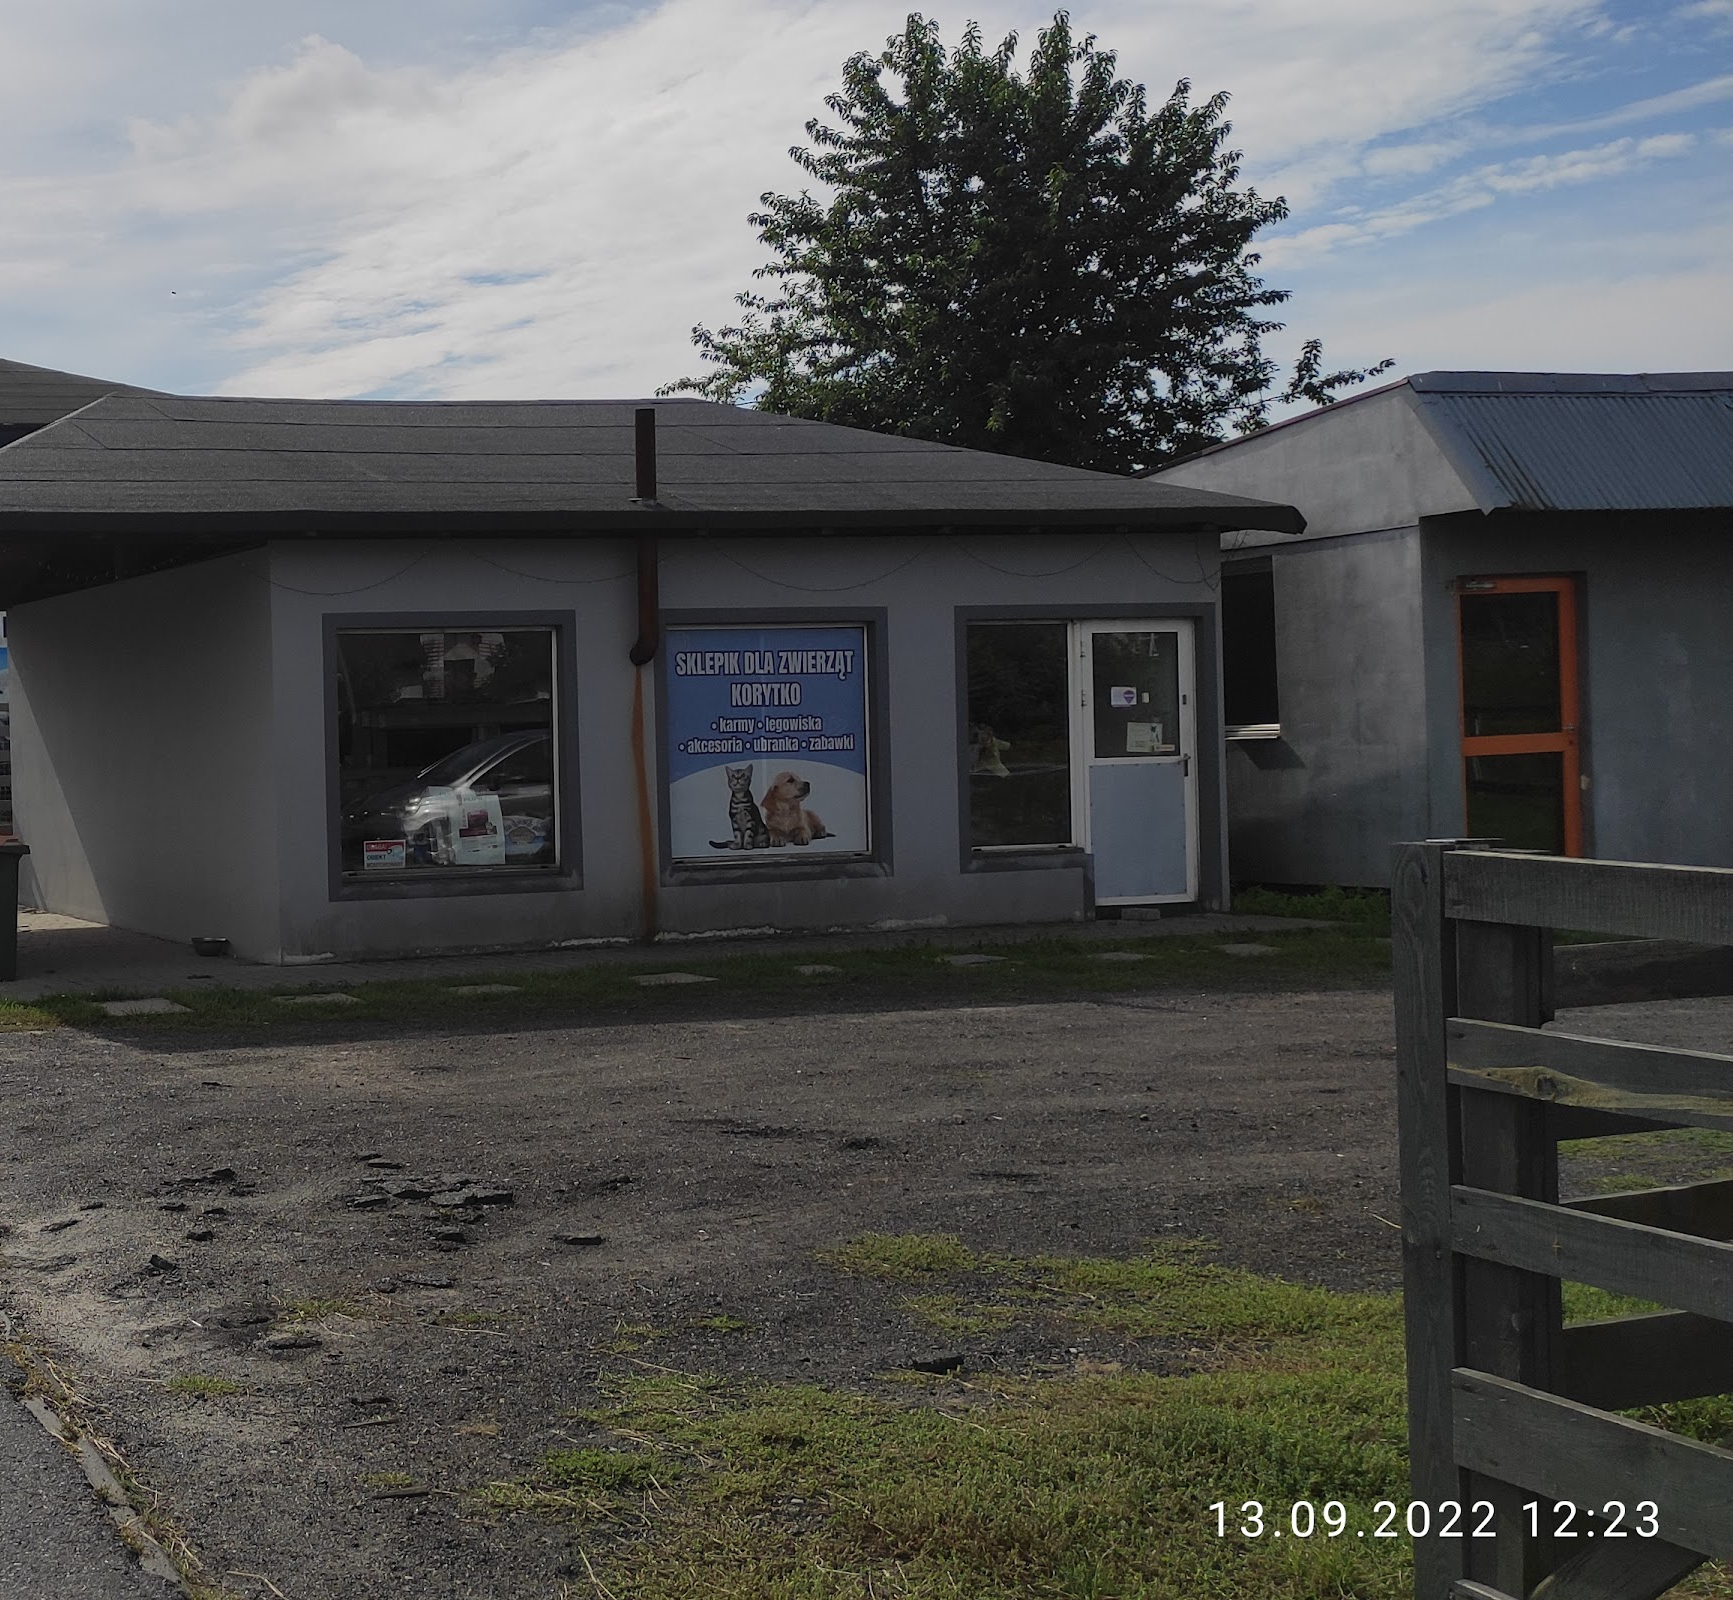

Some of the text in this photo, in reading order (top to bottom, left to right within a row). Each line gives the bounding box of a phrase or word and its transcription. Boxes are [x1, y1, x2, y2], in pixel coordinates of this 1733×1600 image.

[675, 651, 854, 680] SKLEPIK DLA ZWIERZĄT
[731, 683, 802, 706] KORYTKO
[719, 715, 822, 734] karmy legowiska
[687, 734, 854, 753] akcesoria ubranka zabawki
